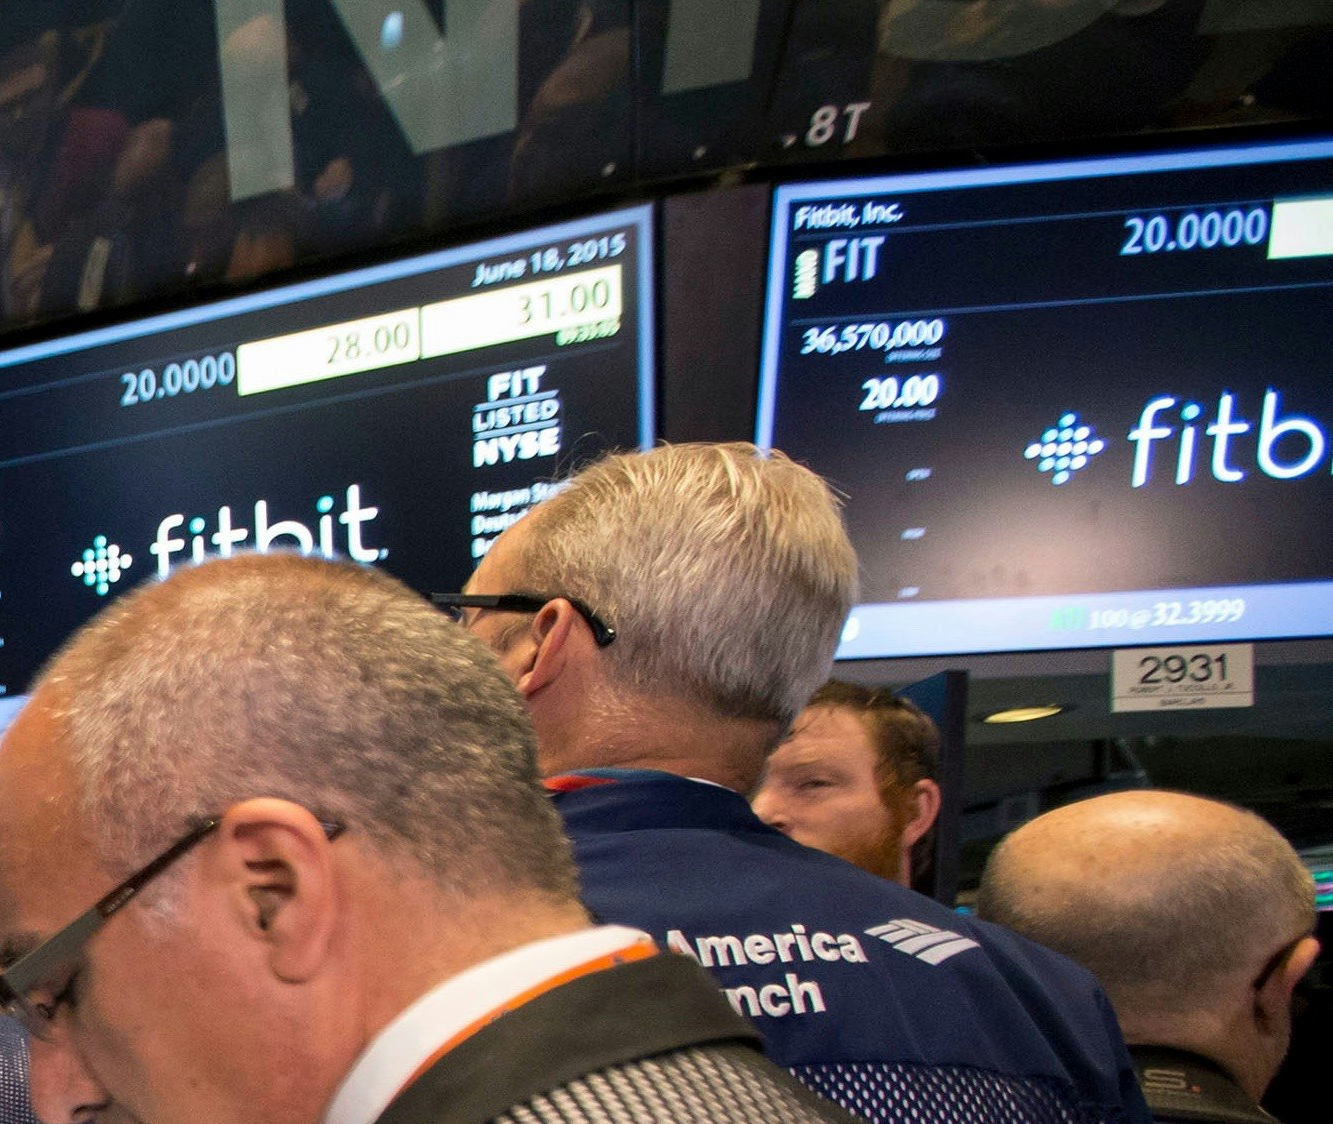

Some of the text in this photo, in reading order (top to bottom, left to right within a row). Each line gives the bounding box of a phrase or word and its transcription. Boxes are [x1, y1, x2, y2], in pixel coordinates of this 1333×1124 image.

[807, 103, 870, 147] 8T
[794, 201, 904, 231] Fitbit, Inc.
[471, 232, 626, 288] June 18, 2015
[822, 236, 886, 284] FIT
[1119, 207, 1268, 256] 20.0000
[519, 279, 610, 326] 31.00
[800, 319, 944, 355] 36,570,000
[120, 351, 235, 407] 20.0000
[326, 322, 410, 364] 28.00
[487, 364, 547, 402] FIT
[859, 374, 939, 411] 20.00
[472, 399, 560, 433] LISTED
[1127, 386, 1333, 488] fitb
[472, 426, 561, 468] NYSE
[149, 484, 379, 582] fitbit
[1140, 653, 1227, 684] 2931
[667, 923, 869, 967] America
[719, 973, 826, 1018] nch
